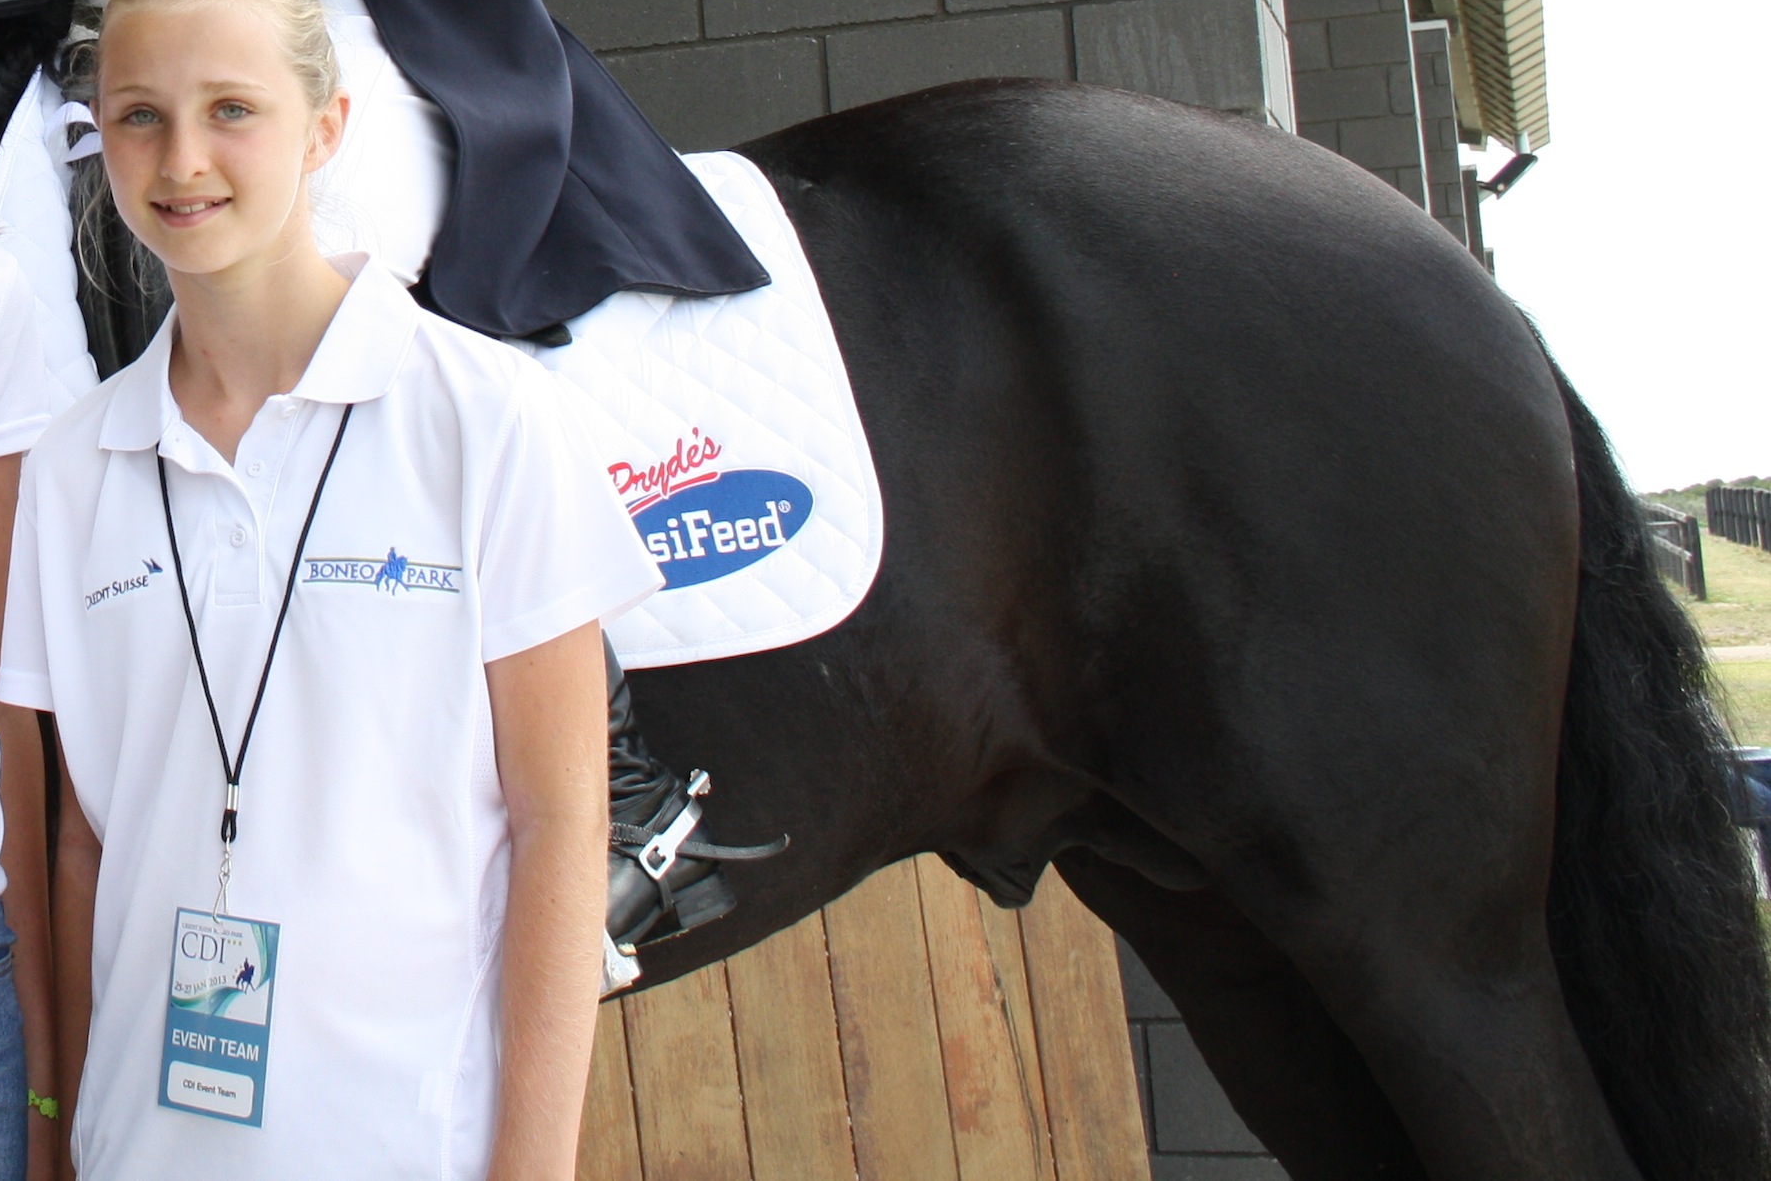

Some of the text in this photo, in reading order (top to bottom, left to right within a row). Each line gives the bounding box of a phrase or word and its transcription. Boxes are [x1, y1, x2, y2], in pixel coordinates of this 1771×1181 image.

[112, 575, 149, 596] SUISSE
[309, 563, 454, 589] BONEO PARK
[181, 931, 227, 964] CDI
[193, 979, 207, 994] JAN
[209, 975, 227, 987] 2013
[172, 1028, 260, 1062] EVENT TEAM
[183, 1079, 237, 1099] CDI Event Team
